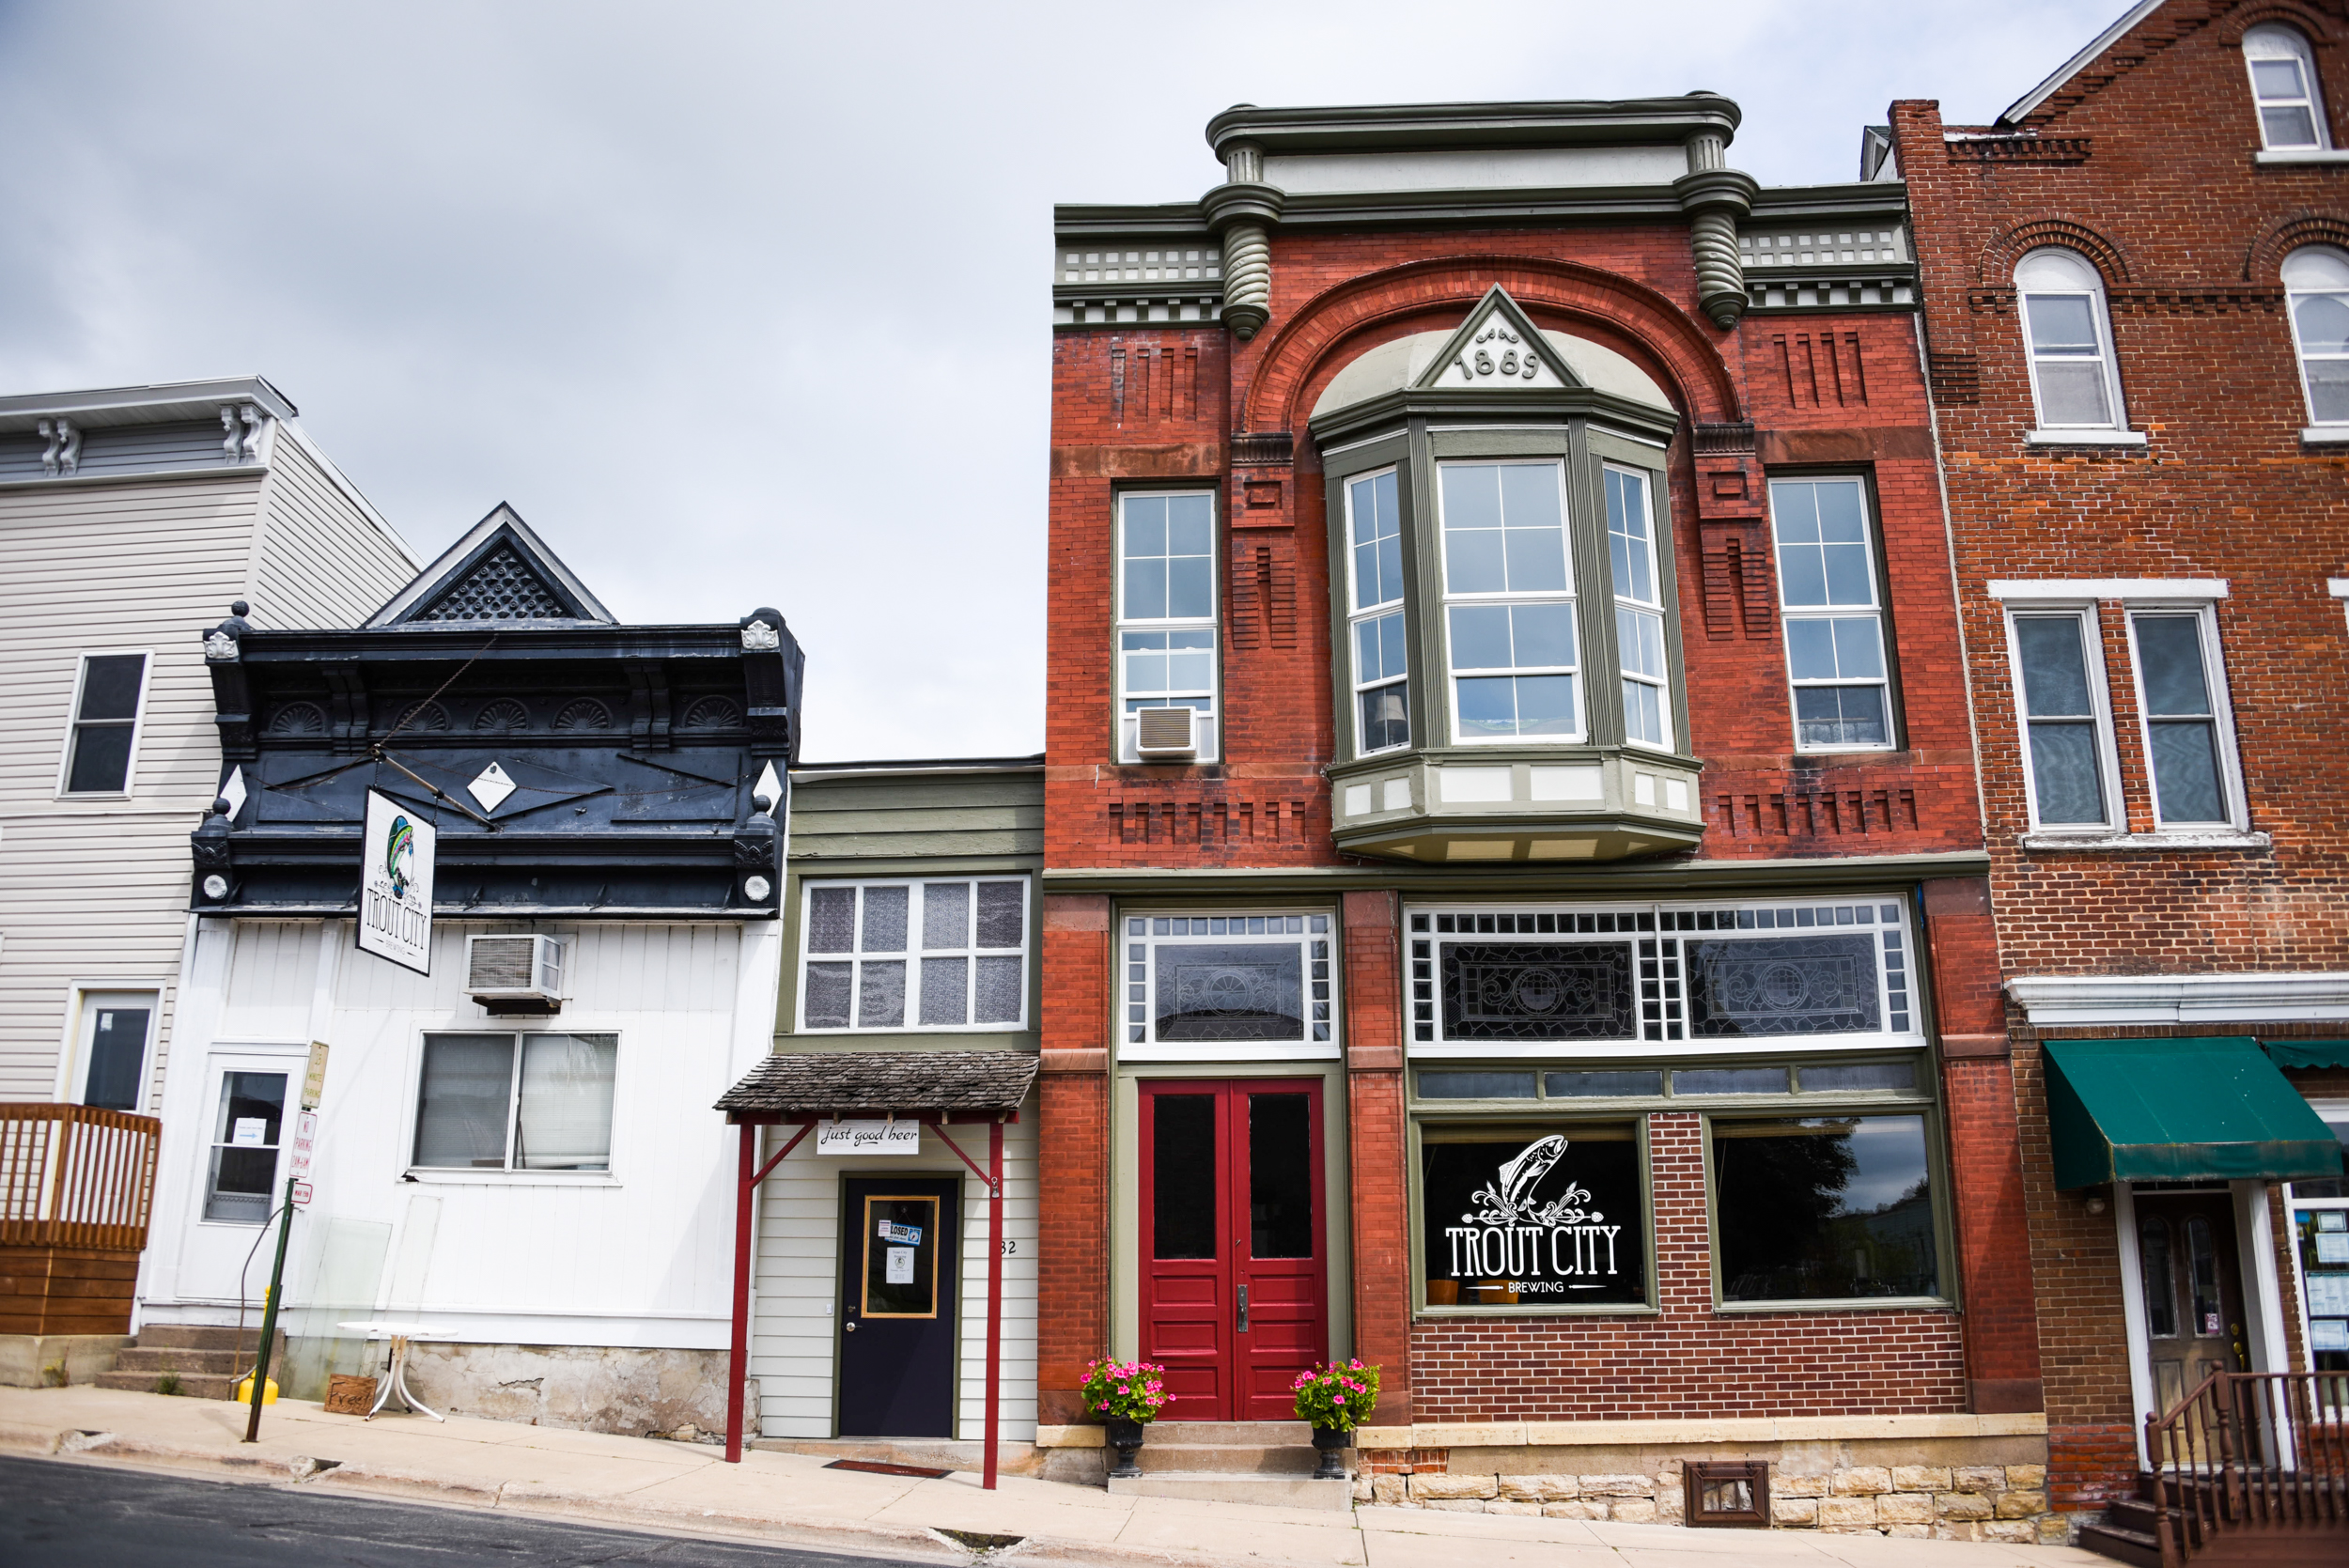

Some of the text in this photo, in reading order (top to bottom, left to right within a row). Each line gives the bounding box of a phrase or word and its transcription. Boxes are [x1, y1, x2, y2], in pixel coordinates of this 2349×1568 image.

[1455, 349, 1541, 380] 1889
[366, 888, 427, 950] TROUT CITY
[385, 939, 406, 955] BREWING
[303, 1087, 320, 1099] PARKING
[303, 1121, 310, 1133] NO
[820, 1126, 917, 1147] just good beer
[294, 1137, 312, 1152] PARKING
[891, 1226, 908, 1235] LOSED
[1446, 1225, 1621, 1277] TROUT CITY
[1508, 1281, 1564, 1293] BREWING
